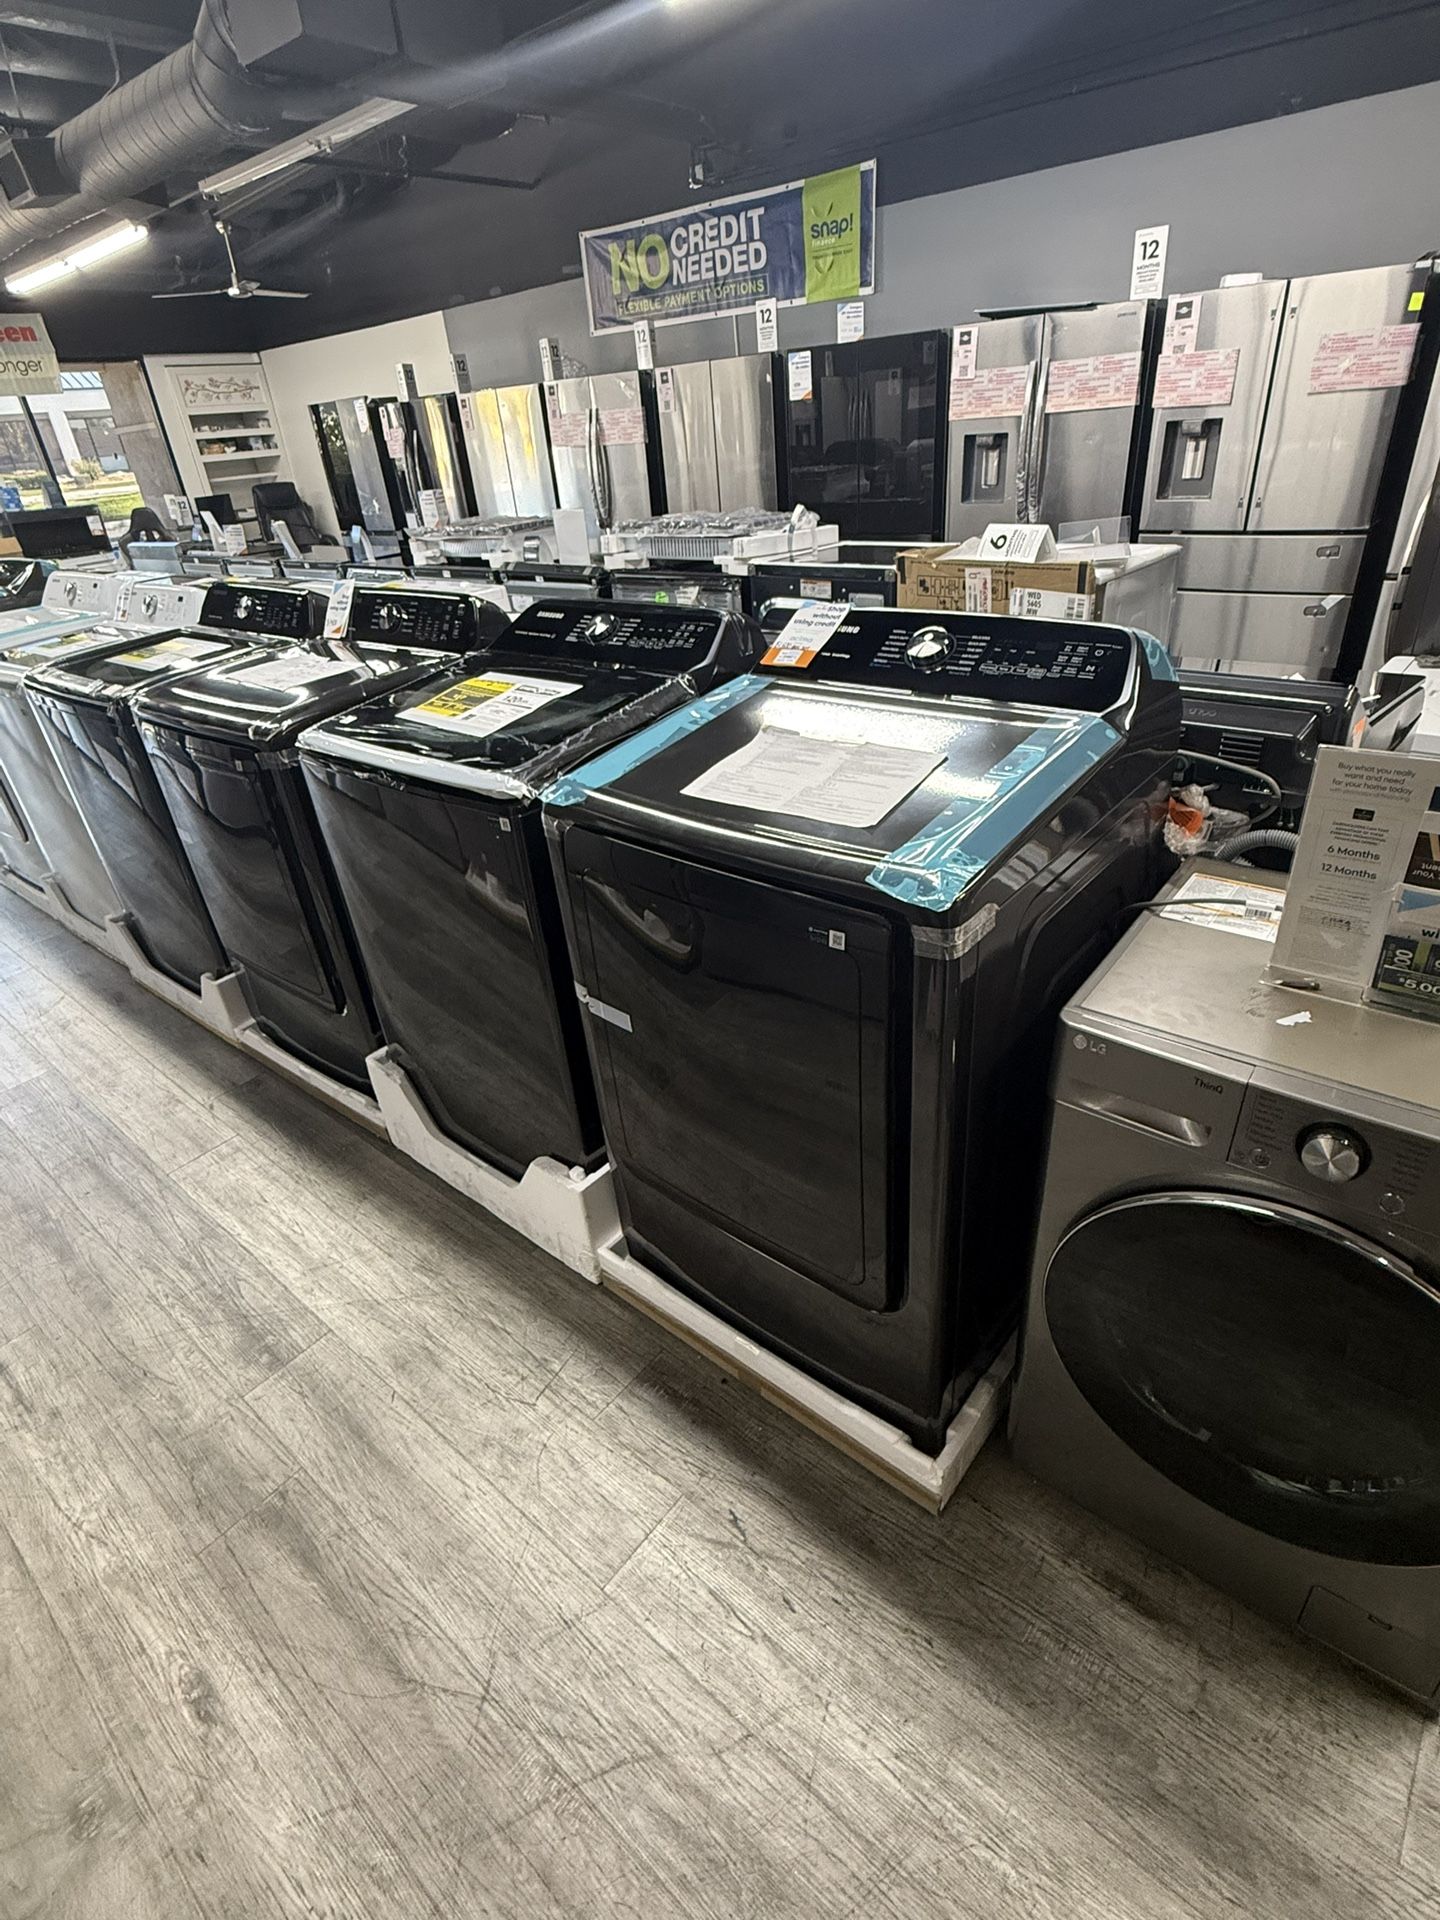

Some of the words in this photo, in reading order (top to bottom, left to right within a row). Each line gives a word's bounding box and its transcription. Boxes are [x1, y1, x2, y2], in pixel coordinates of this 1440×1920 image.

[811, 212, 854, 239] snap!
[608, 233, 670, 295] NO
[670, 206, 765, 258] CREDIT
[1140, 239, 1160, 261] 12
[672, 241, 768, 286] NEEDED
[618, 298, 663, 315] FLEXIBLE
[664, 288, 711, 308] PAYMENT
[712, 278, 765, 299] OPTIONS
[760, 307, 772, 324] 12
[636, 328, 647, 343] 12
[550, 345, 560, 358] 12
[457, 359, 467, 372] 12
[177, 501, 188, 510] 12
[990, 534, 1007, 550] 6
[1027, 591, 1042, 600] WED
[793, 618, 813, 627] using
[1338, 762, 1354, 772] Buy
[1355, 764, 1375, 773] what
[1376, 767, 1393, 775] you
[1393, 768, 1416, 779] really
[1332, 777, 1344, 786] for
[1345, 780, 1362, 788] your
[1363, 782, 1388, 792] home
[1388, 785, 1414, 796] today
[1365, 774, 1383, 782] and
[1384, 777, 1406, 785] need
[1327, 844, 1335, 853] 6
[1337, 846, 1380, 861] Months
[1321, 862, 1333, 872] 12
[1334, 865, 1377, 880] Months
[1090, 1041, 1107, 1056] LG
[1194, 1076, 1224, 1095] ThinQ
